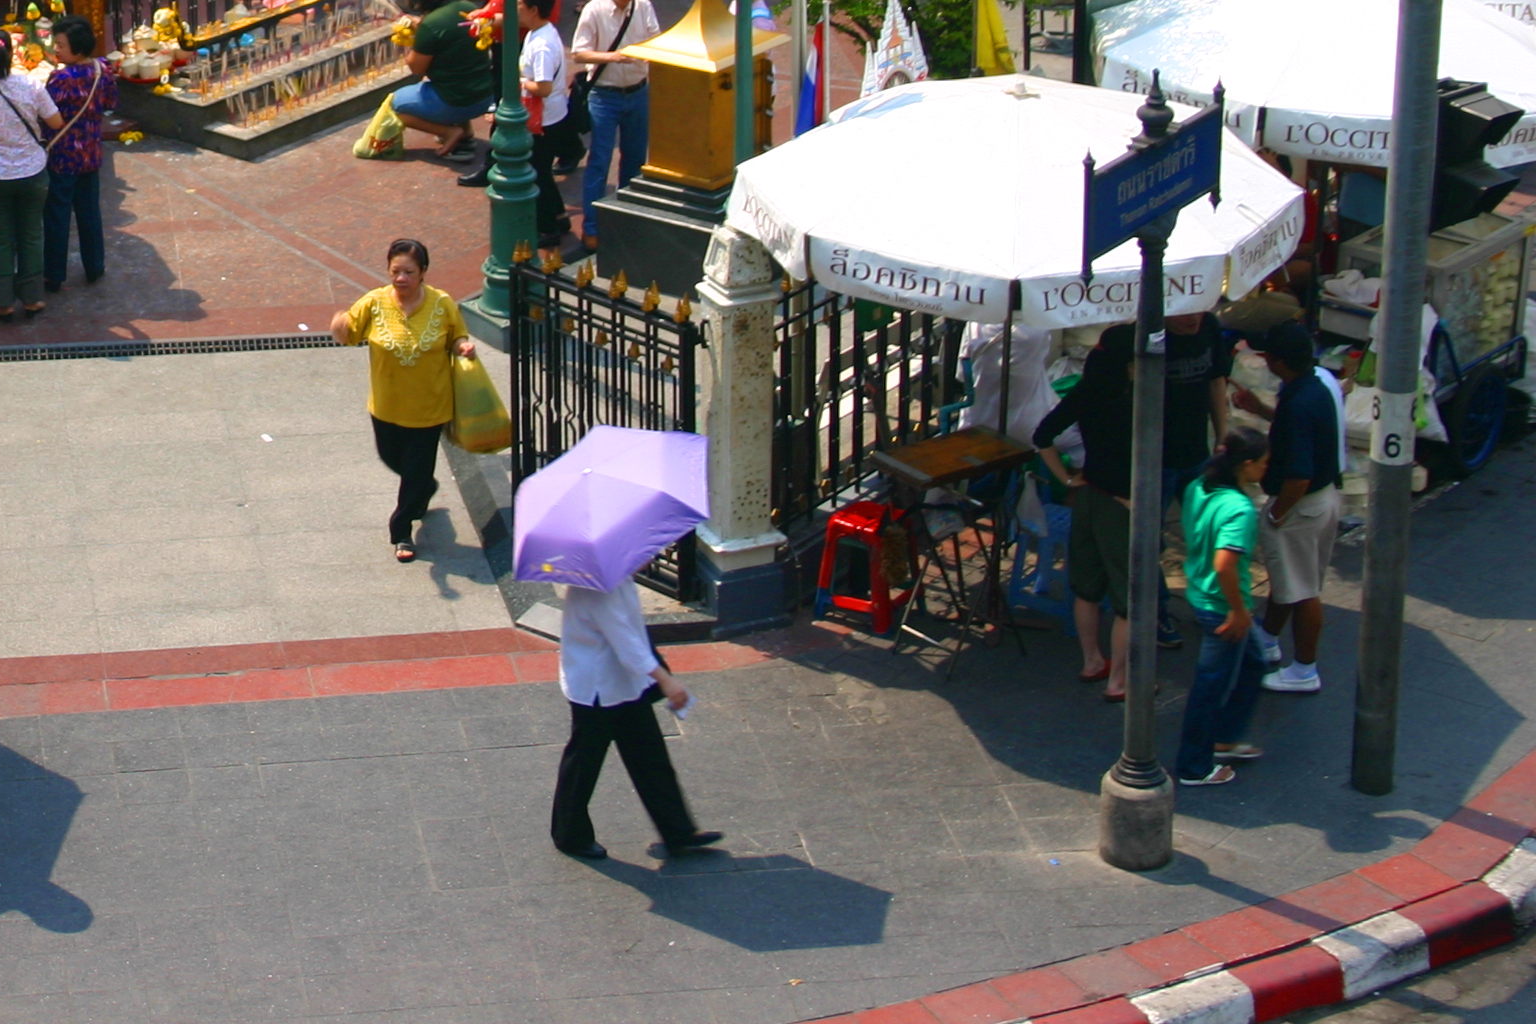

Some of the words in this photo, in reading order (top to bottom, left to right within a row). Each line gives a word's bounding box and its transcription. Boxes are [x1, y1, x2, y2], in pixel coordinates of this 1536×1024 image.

[1284, 122, 1390, 149] L'OCCIT
[1338, 150, 1383, 160] PROVE
[1043, 274, 1205, 312] L'OCCINE
[1384, 433, 1402, 458] 6
